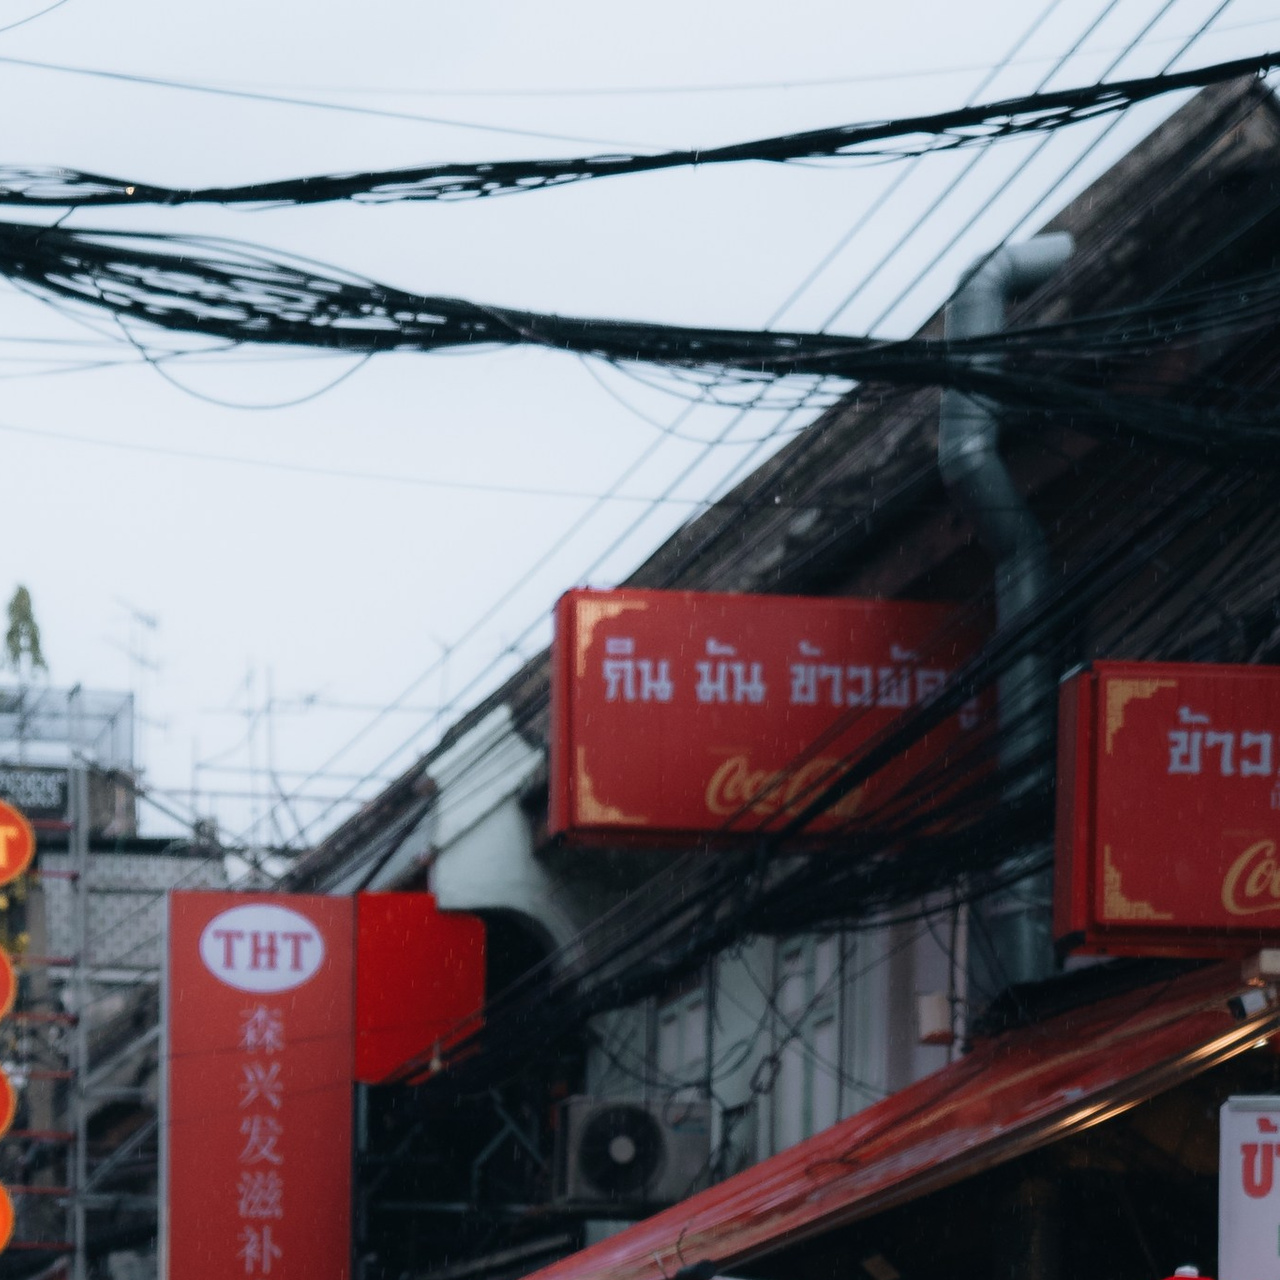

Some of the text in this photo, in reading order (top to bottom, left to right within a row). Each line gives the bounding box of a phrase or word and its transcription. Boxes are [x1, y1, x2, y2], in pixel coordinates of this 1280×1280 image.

[695, 636, 766, 703] มัน
[1167, 705, 1280, 777] ข้าว
[213, 929, 313, 972] THT
